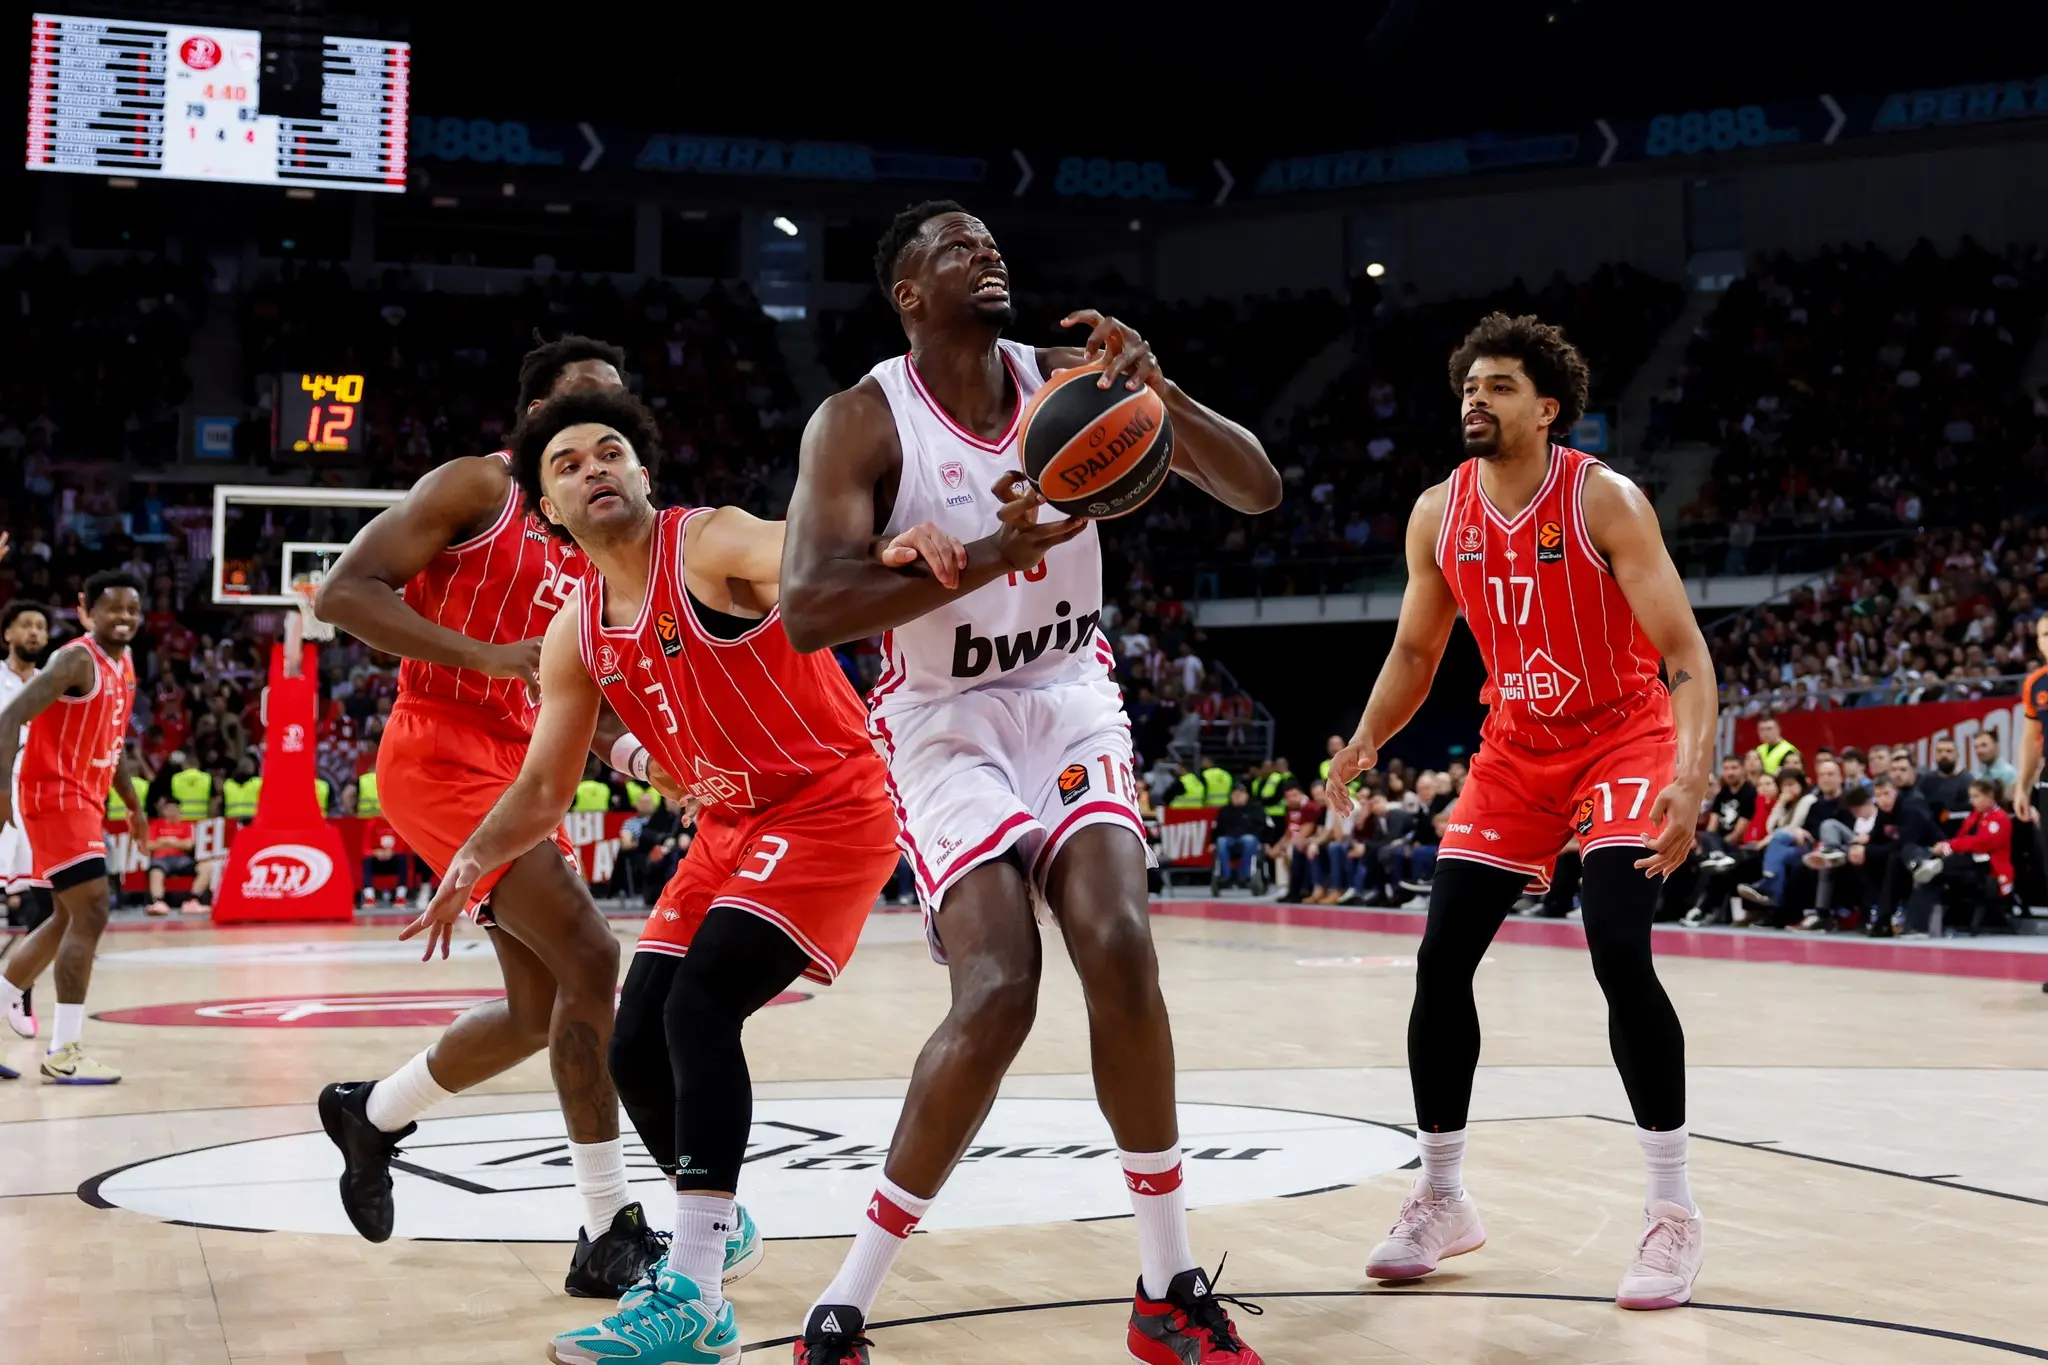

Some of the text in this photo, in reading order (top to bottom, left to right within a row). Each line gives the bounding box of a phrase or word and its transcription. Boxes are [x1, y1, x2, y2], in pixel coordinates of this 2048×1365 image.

[1645, 104, 1766, 156] 8888
[1054, 156, 1170, 198] 8888
[301, 374, 364, 403] 4:40
[308, 405, 354, 445] 12
[1059, 407, 1156, 494] SPALDING
[525, 529, 549, 545] RTMI
[1458, 552, 1483, 562] RTMI
[1488, 576, 1534, 625] 17
[951, 600, 1100, 678] bwin
[600, 673, 623, 687] RTMI
[1526, 672, 1561, 699] IBI
[644, 682, 678, 735] 3
[1594, 777, 1650, 823] 17
[1447, 823, 1474, 835] uvei
[739, 835, 789, 882] 3
[936, 838, 963, 866] FlexCar
